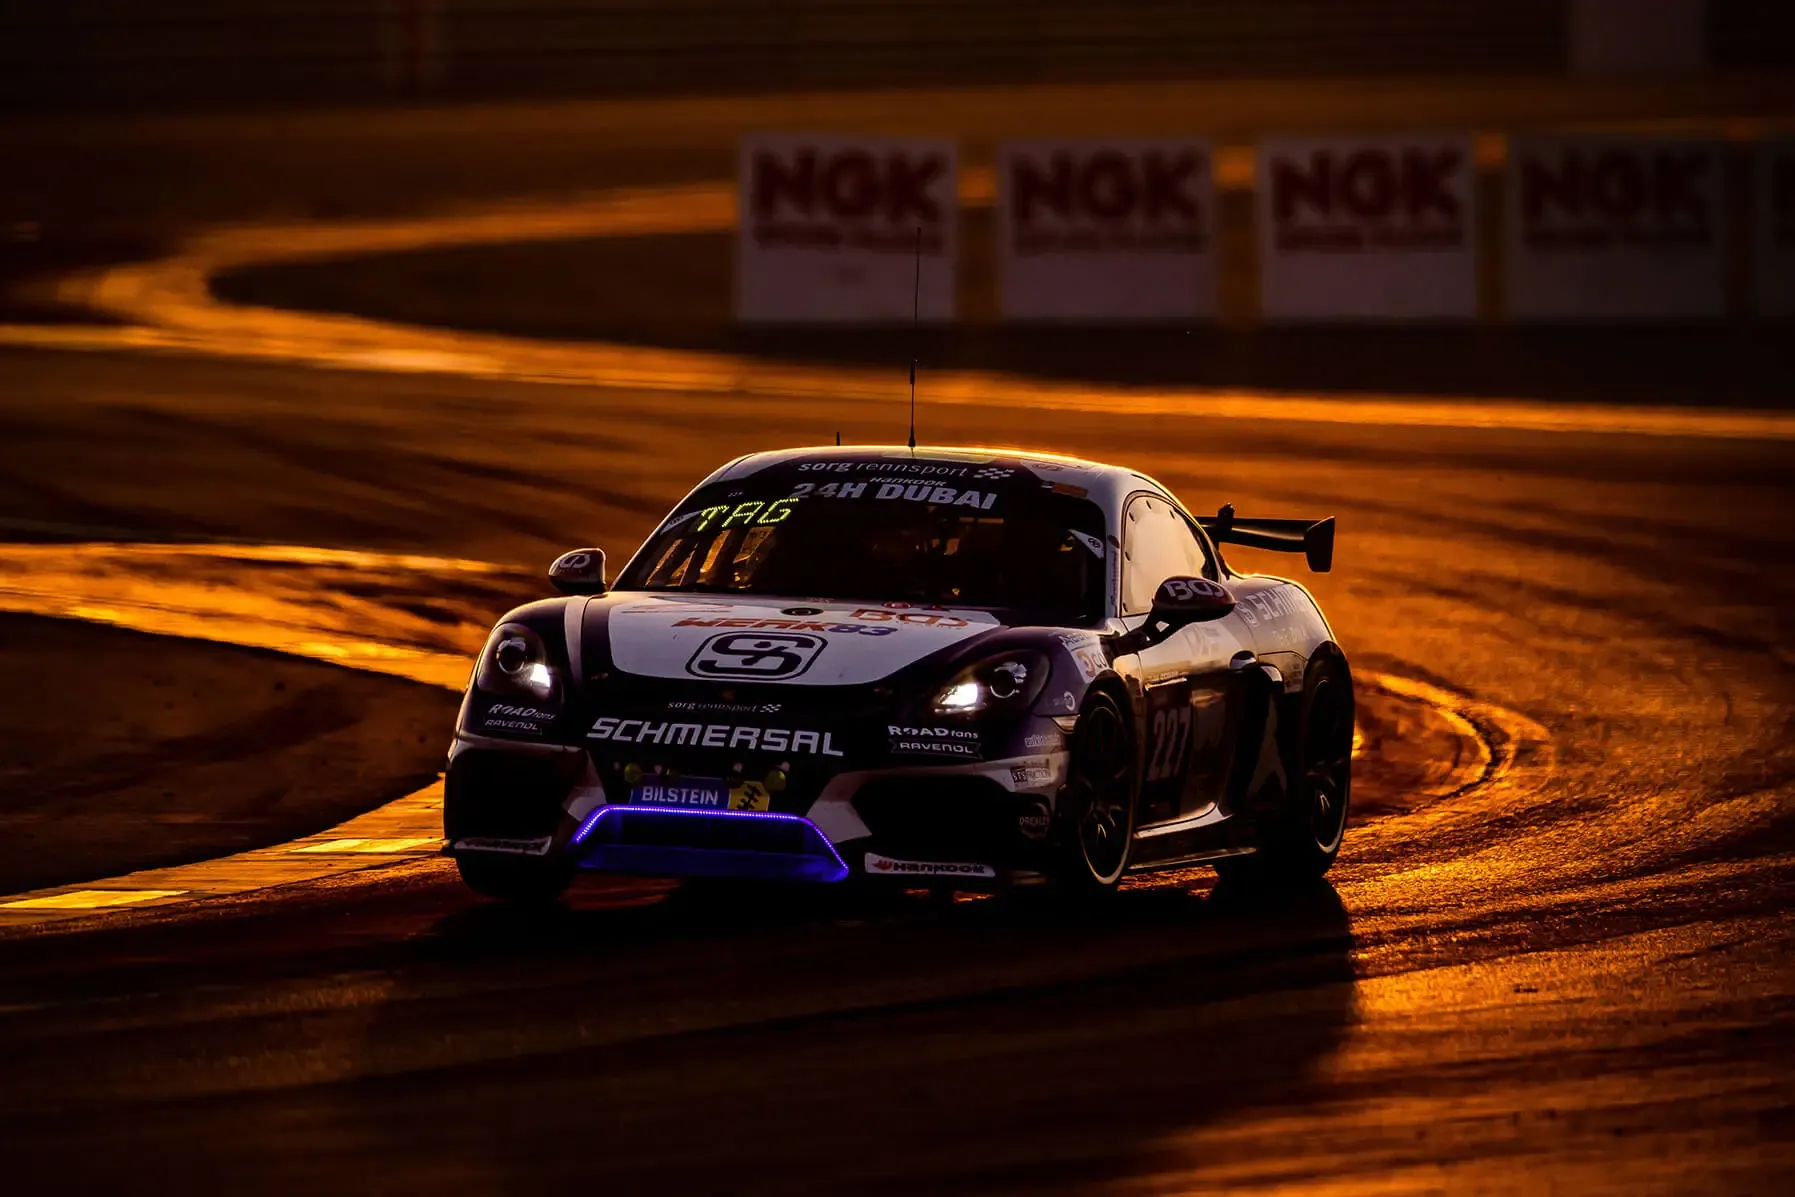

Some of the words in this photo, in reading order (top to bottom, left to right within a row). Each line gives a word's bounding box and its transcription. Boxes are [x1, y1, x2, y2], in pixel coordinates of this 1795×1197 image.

[755, 148, 946, 221] NGK
[1014, 150, 1198, 220] NGK
[1274, 148, 1462, 220] NGK
[1523, 151, 1709, 219] NGK
[798, 462, 856, 473] sorg
[856, 462, 969, 478] rennsport
[791, 481, 867, 499] 24H
[875, 483, 1000, 511] DUBAI
[697, 497, 799, 533] TAG
[672, 617, 899, 636] WERK83
[667, 701, 697, 711] sorg
[484, 719, 539, 731] RAVENOL
[586, 716, 845, 757] SCHMERSAL
[899, 742, 974, 754] RAVENOL
[1147, 707, 1192, 782] 227
[641, 785, 719, 806] BILSTEIN
